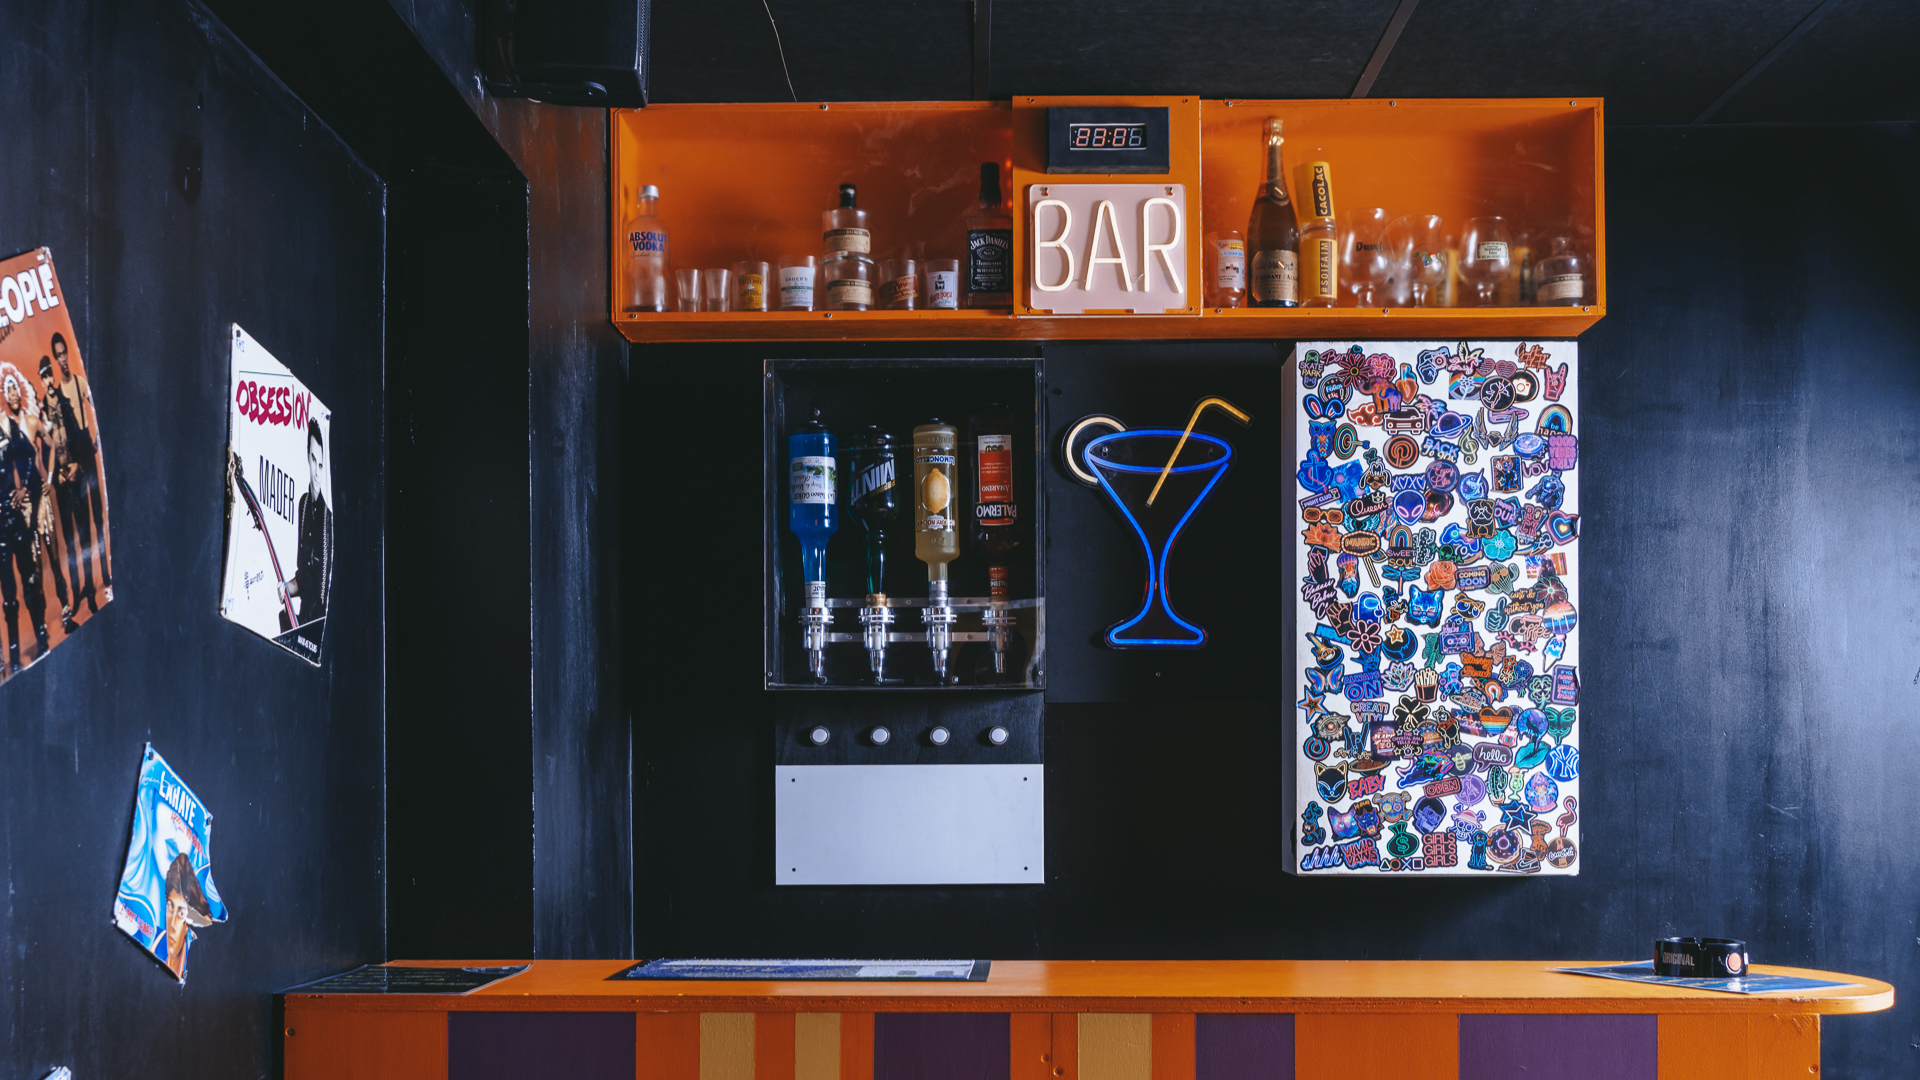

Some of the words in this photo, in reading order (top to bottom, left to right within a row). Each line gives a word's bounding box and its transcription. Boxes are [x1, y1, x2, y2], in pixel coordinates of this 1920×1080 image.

[1315, 166, 1329, 216] CACOLAC
[629, 231, 668, 244] ABSOLUT
[970, 237, 985, 250] JACK
[633, 240, 665, 253] VODKA
[1035, 197, 1183, 294] BAR
[1320, 241, 1329, 293] #SOIFAIM
[1299, 361, 1323, 371] SKATE
[1302, 368, 1321, 377] PARK
[235, 379, 312, 431] OBSESSION
[1549, 434, 1576, 447] GOOD
[1424, 438, 1459, 458] BACK
[915, 455, 956, 465] LIMONCELLO
[1549, 457, 1575, 469] ONLY
[854, 458, 896, 503] MINT
[259, 454, 295, 525] MADER
[981, 484, 1010, 493] AMARINO
[1318, 493, 1332, 502] CLUB
[976, 503, 1017, 518] PALERMO
[1350, 500, 1388, 516] Queen
[1345, 536, 1376, 548] MUSIC
[1387, 549, 1416, 557] SWEET
[1388, 557, 1416, 567] SOUL
[1458, 569, 1486, 578] COMING
[1459, 576, 1487, 587] SOON
[1344, 671, 1380, 684] ALWAYS
[1344, 680, 1383, 701] ON
[1351, 701, 1388, 713] CREATI
[1479, 746, 1507, 763] hello
[1347, 775, 1384, 799] BABY
[1426, 779, 1460, 797] OPEN
[159, 771, 197, 828] LAHAYE
[1423, 832, 1456, 842] GIRLS
[1423, 843, 1457, 855] GIRLS
[1424, 855, 1457, 867] GIRLS
[1662, 951, 1696, 967] ORIGINAL
